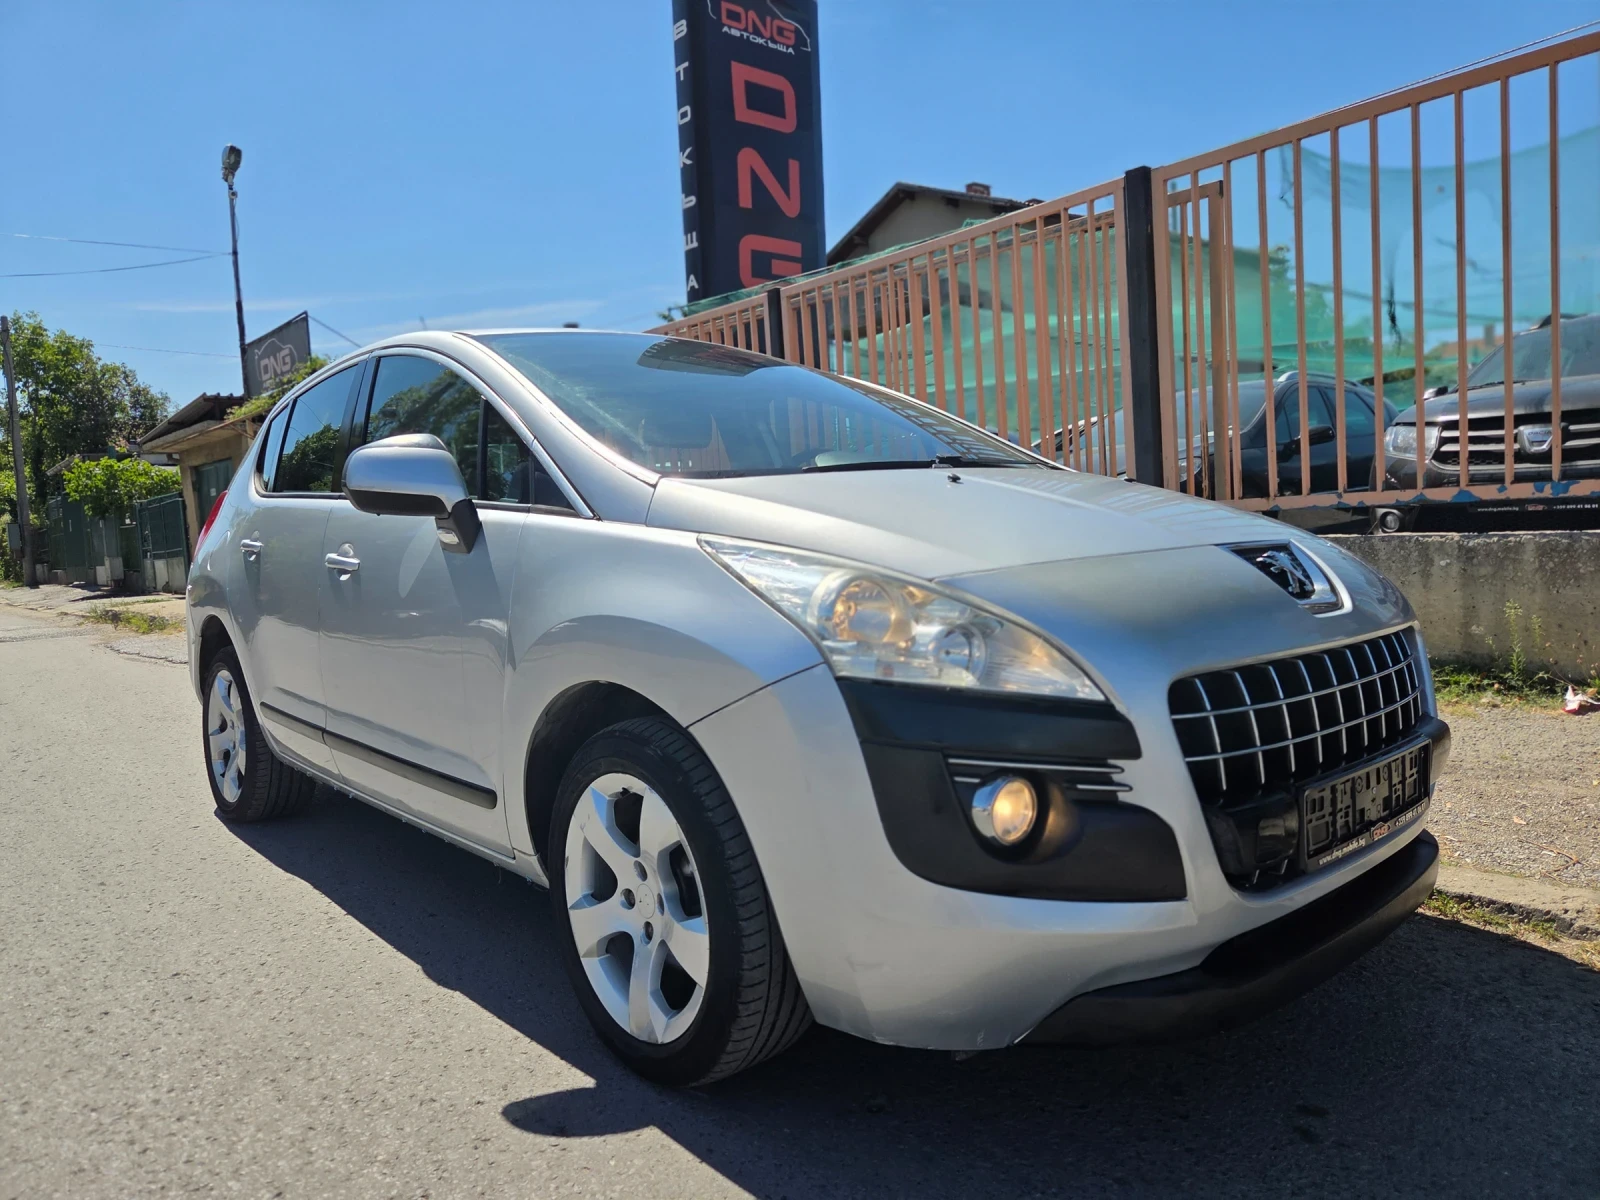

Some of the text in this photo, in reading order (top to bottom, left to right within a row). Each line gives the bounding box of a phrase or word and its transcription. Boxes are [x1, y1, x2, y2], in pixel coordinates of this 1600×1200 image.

[721, 1, 795, 46] DNG
[731, 60, 803, 289] DNG
[260, 348, 291, 381] DNG
